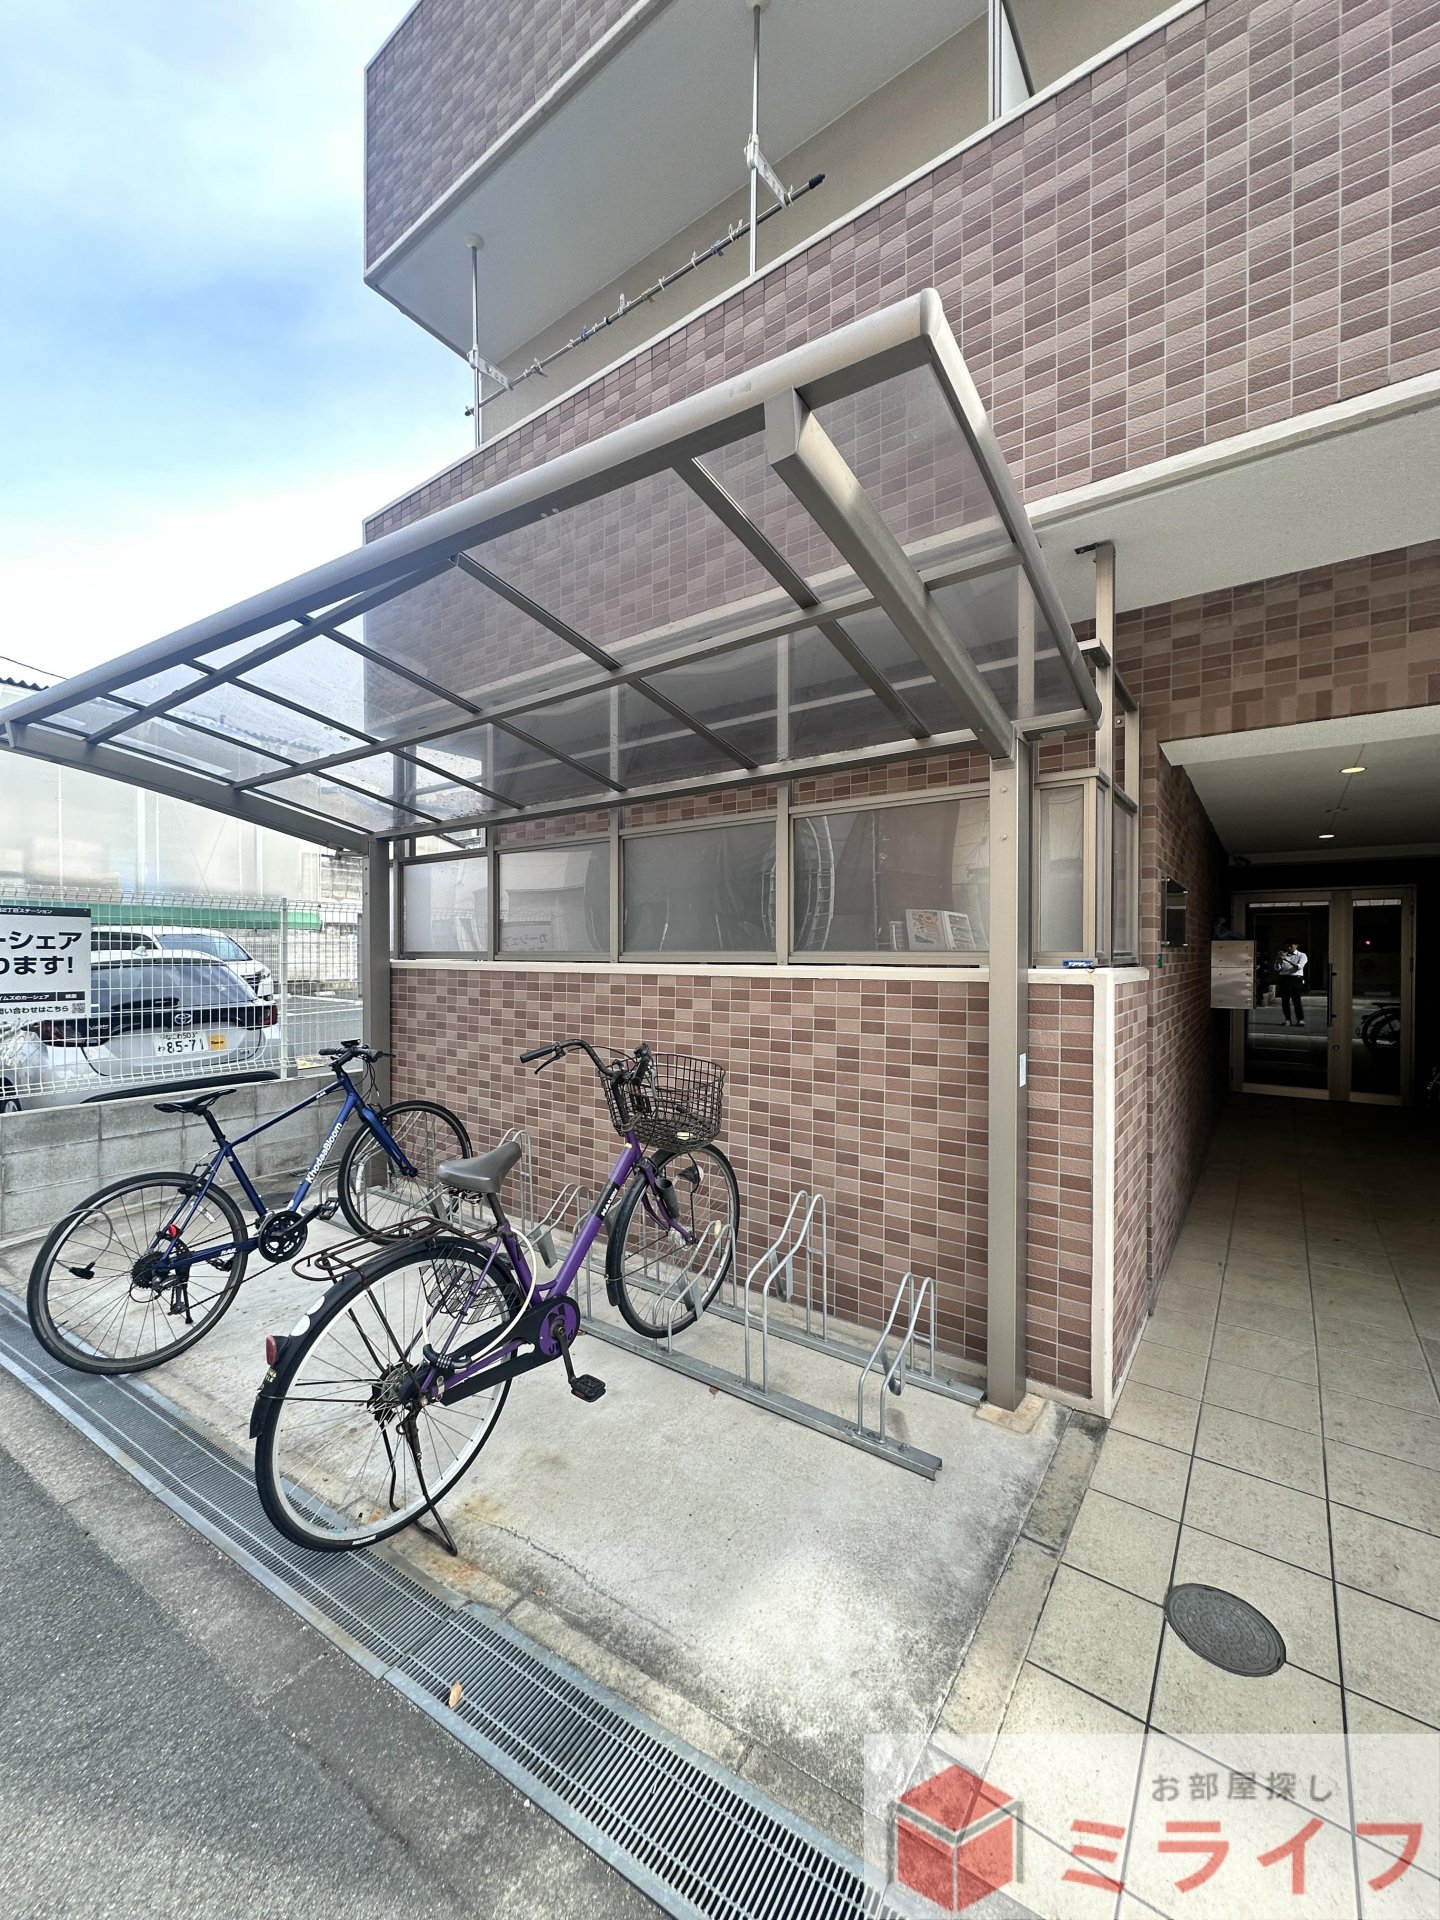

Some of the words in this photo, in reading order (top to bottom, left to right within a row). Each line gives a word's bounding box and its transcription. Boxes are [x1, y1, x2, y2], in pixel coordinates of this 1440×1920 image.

[0, 931, 82, 950] シェア
[305, 1122, 343, 1184] KhodaaBloom
